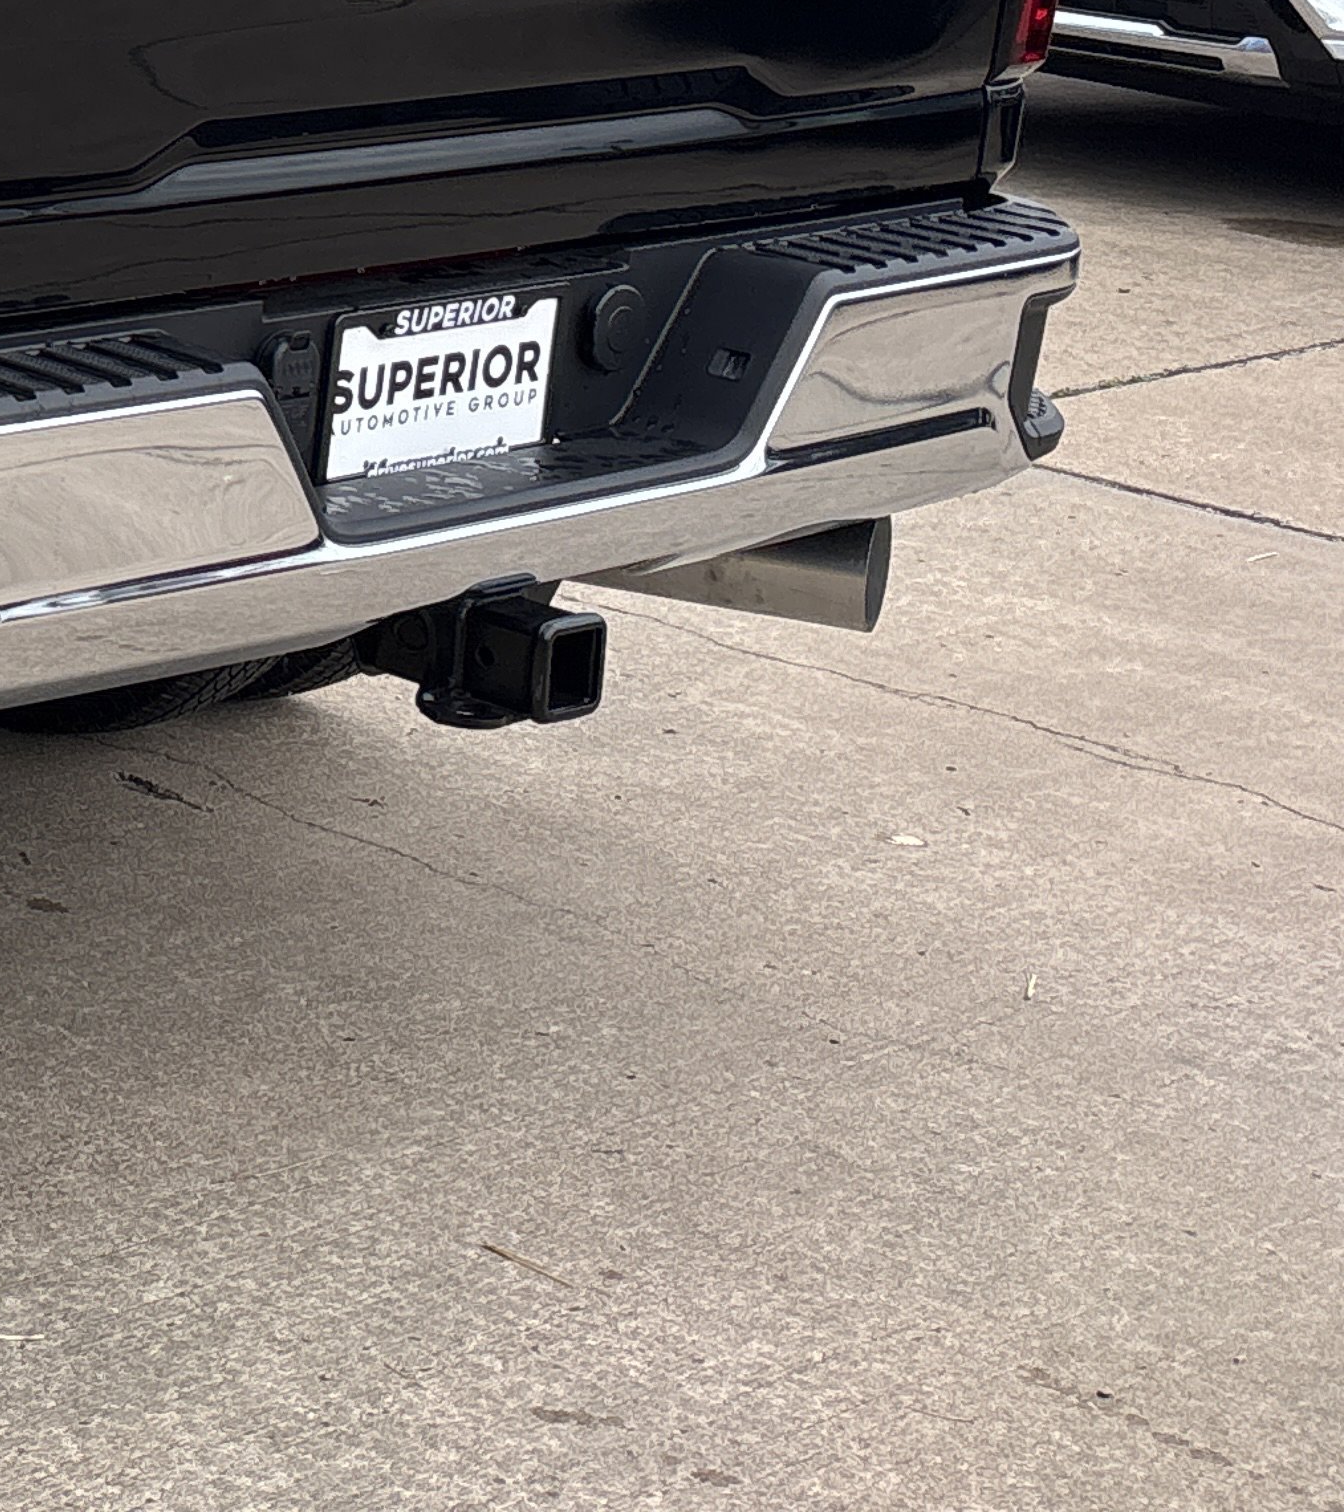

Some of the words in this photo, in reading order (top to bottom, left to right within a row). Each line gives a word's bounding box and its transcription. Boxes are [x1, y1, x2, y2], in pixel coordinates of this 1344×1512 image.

[394, 295, 516, 335] SUPERIOR
[332, 341, 541, 414] SUPERIOR
[331, 400, 456, 435] UTOMOTIVE
[469, 389, 538, 412] GROUP
[367, 445, 510, 478] drivesuperiorcom
